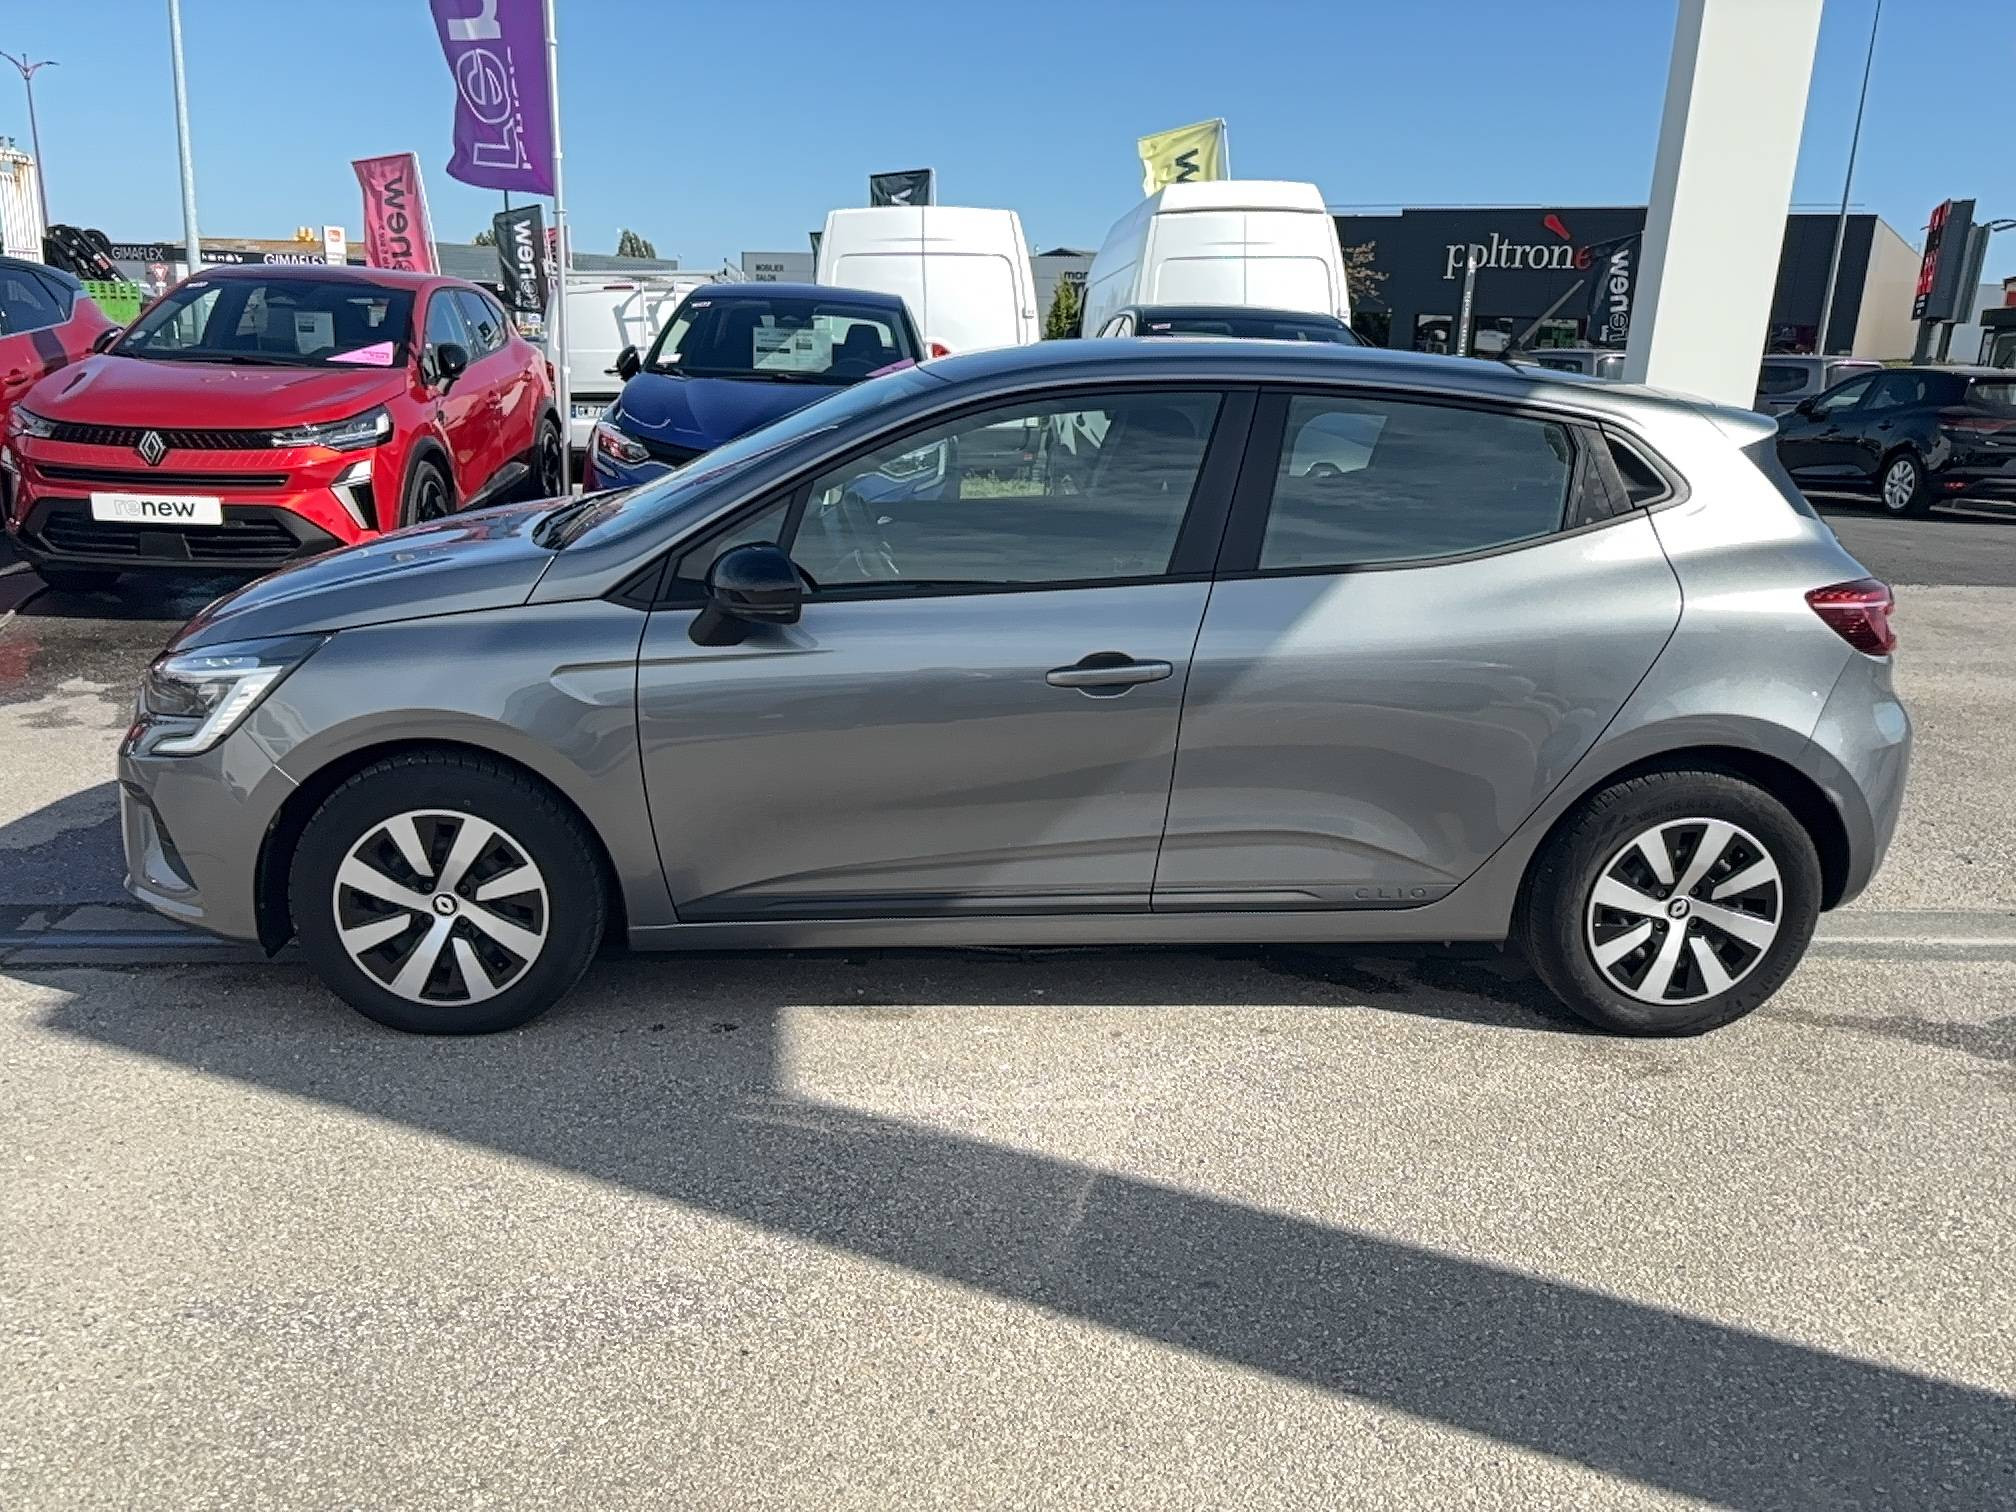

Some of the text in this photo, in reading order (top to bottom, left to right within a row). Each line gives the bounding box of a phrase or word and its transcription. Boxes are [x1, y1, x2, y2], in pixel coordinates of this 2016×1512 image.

[111, 247, 163, 260] GIMAFLEX
[113, 499, 195, 517] renew
[1355, 887, 1427, 900] CLIO
